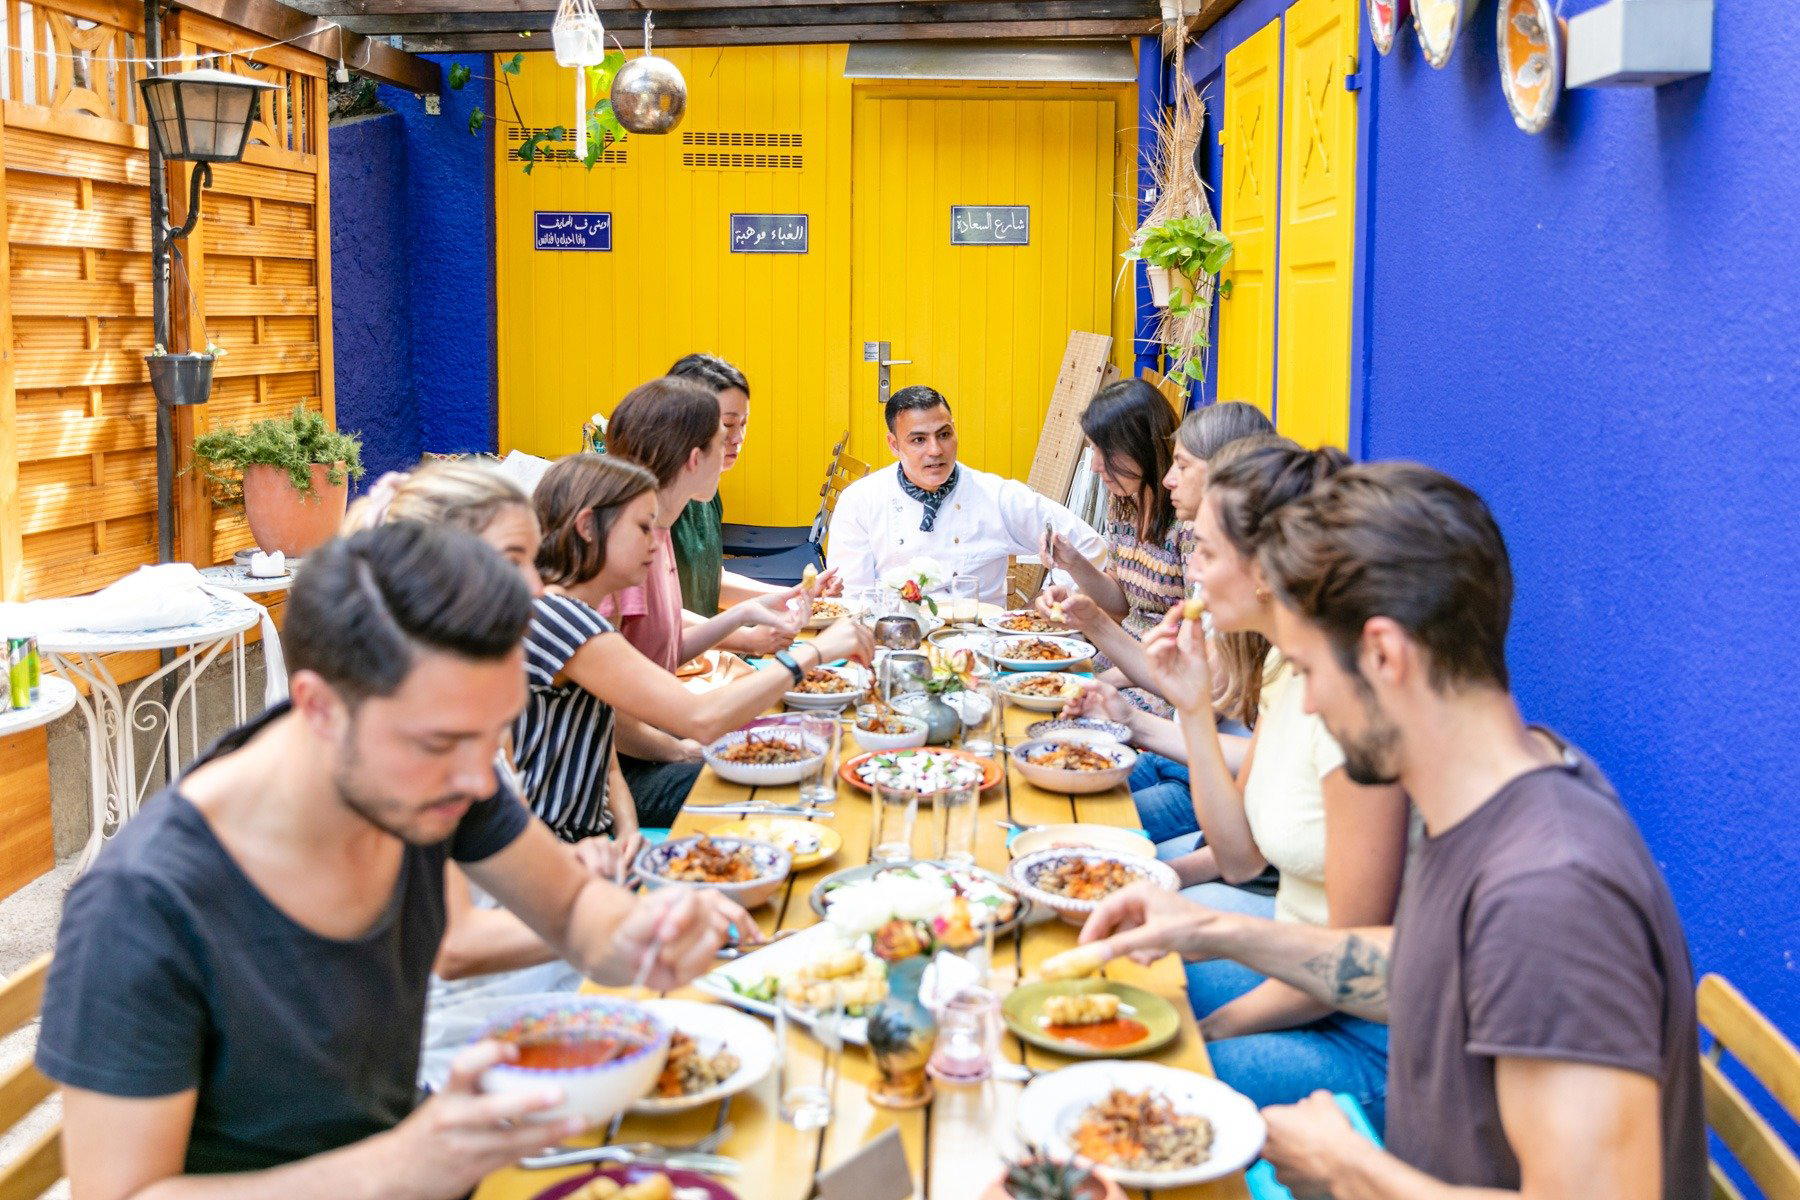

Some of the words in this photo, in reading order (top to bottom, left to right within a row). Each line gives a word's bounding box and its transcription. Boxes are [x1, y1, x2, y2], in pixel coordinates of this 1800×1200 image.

[956, 211, 992, 234] السعادة
[994, 211, 1025, 239] شارع
[771, 223, 804, 246] الغباء
